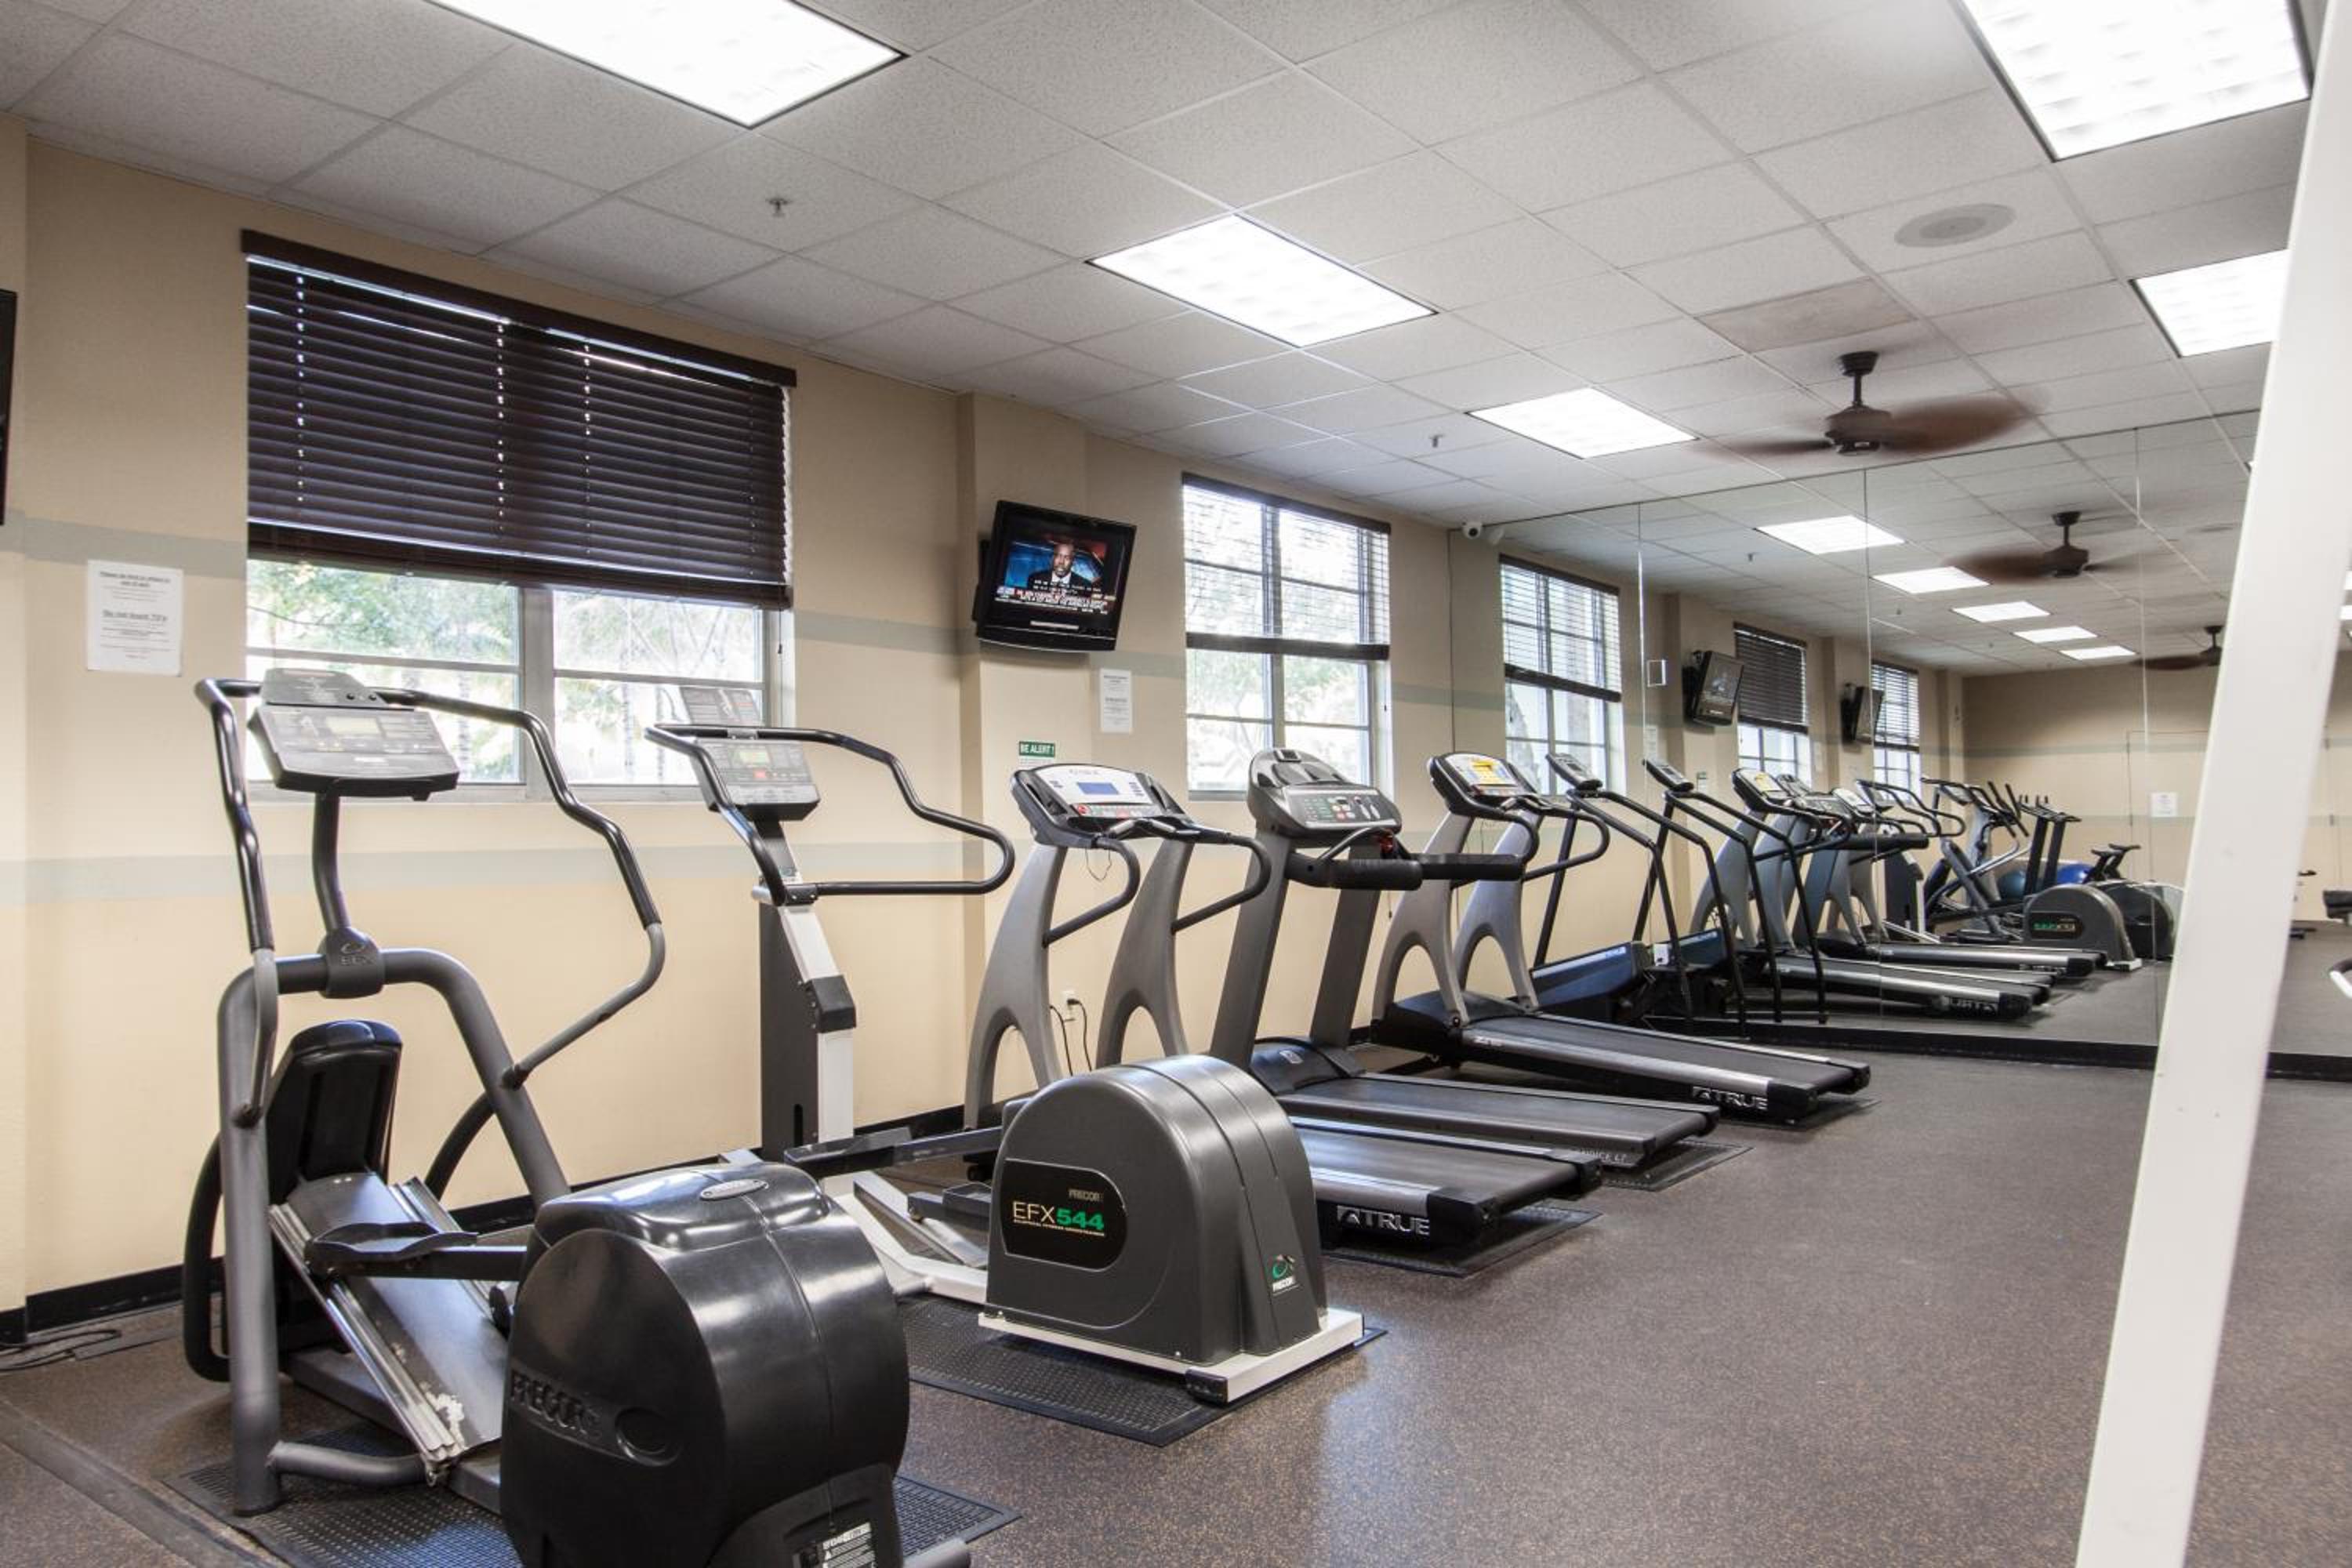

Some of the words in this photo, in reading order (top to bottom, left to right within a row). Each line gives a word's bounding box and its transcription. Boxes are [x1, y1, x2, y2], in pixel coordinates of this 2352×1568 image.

[1021, 744, 1029, 753] BE
[1711, 1089, 1768, 1110] TRUE
[1360, 1208, 1429, 1236] TRUE
[510, 1369, 589, 1436] PRECOR
